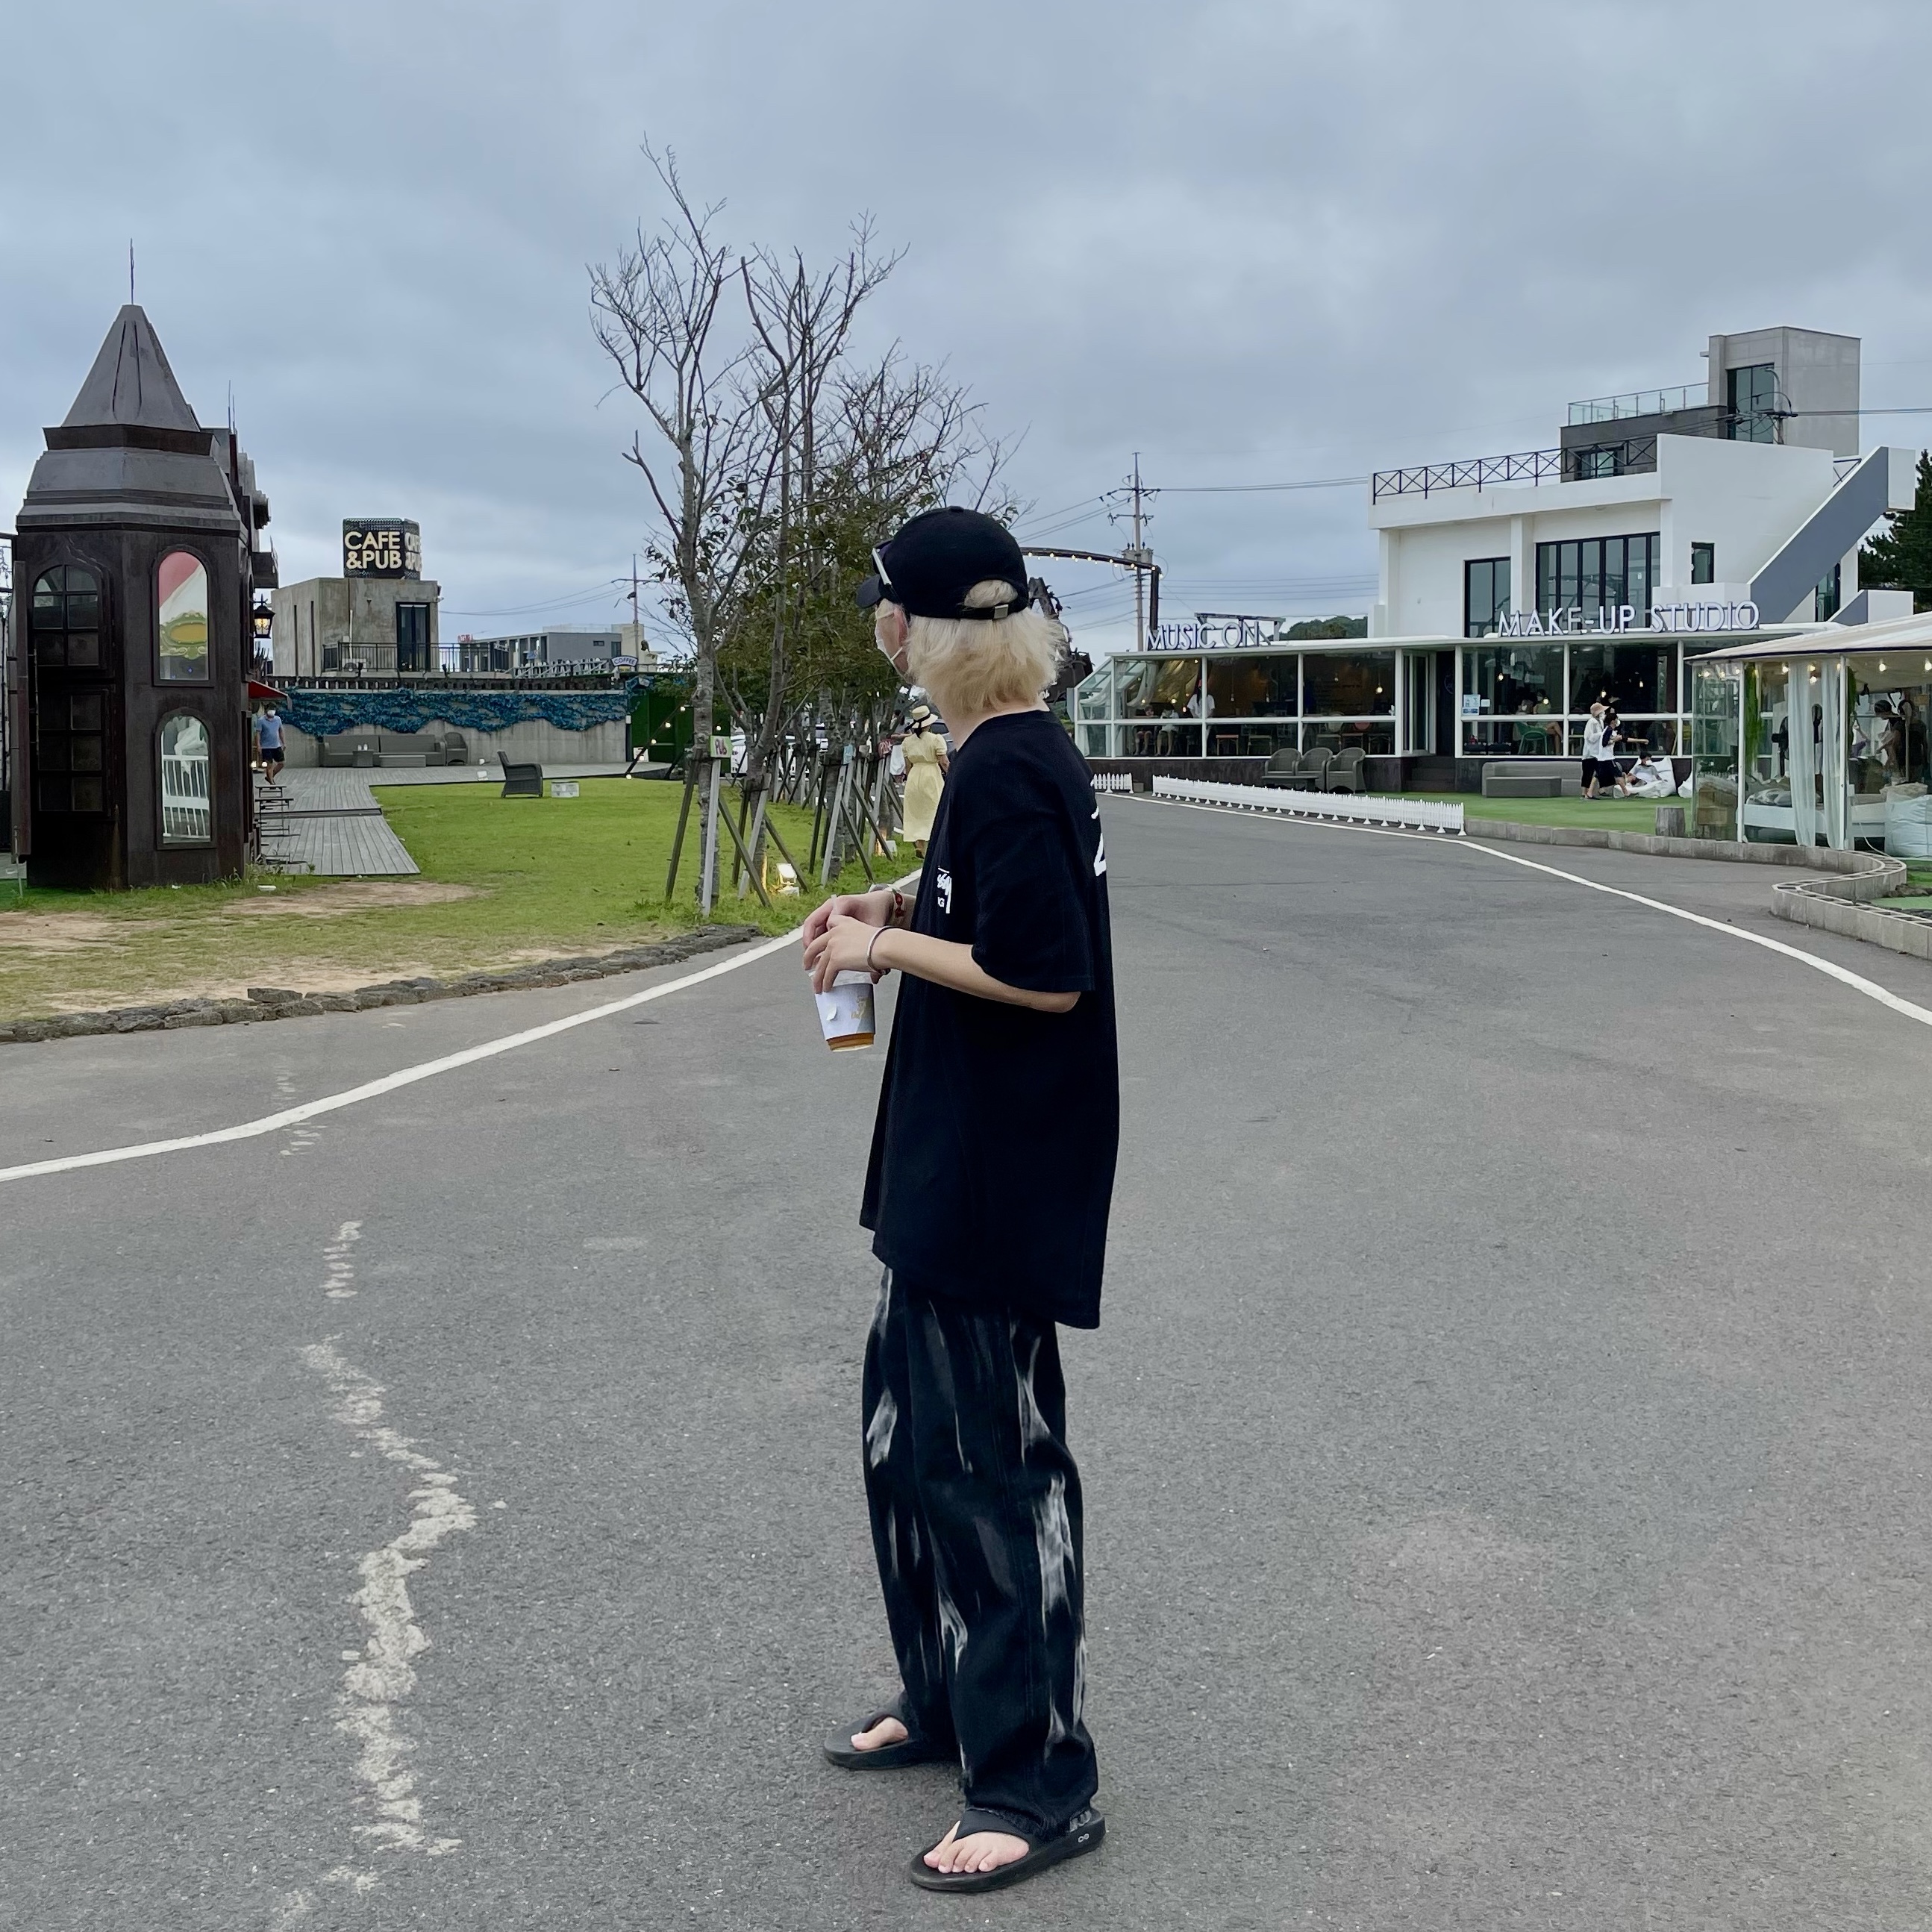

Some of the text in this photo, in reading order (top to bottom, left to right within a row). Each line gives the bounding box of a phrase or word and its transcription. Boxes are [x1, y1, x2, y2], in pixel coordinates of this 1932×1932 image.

[345, 531, 401, 550] CAFE
[346, 550, 402, 569] &PUB
[1498, 601, 1760, 637] MAKE-UP STUDIO
[1143, 622, 1260, 651] MUSIC ON
